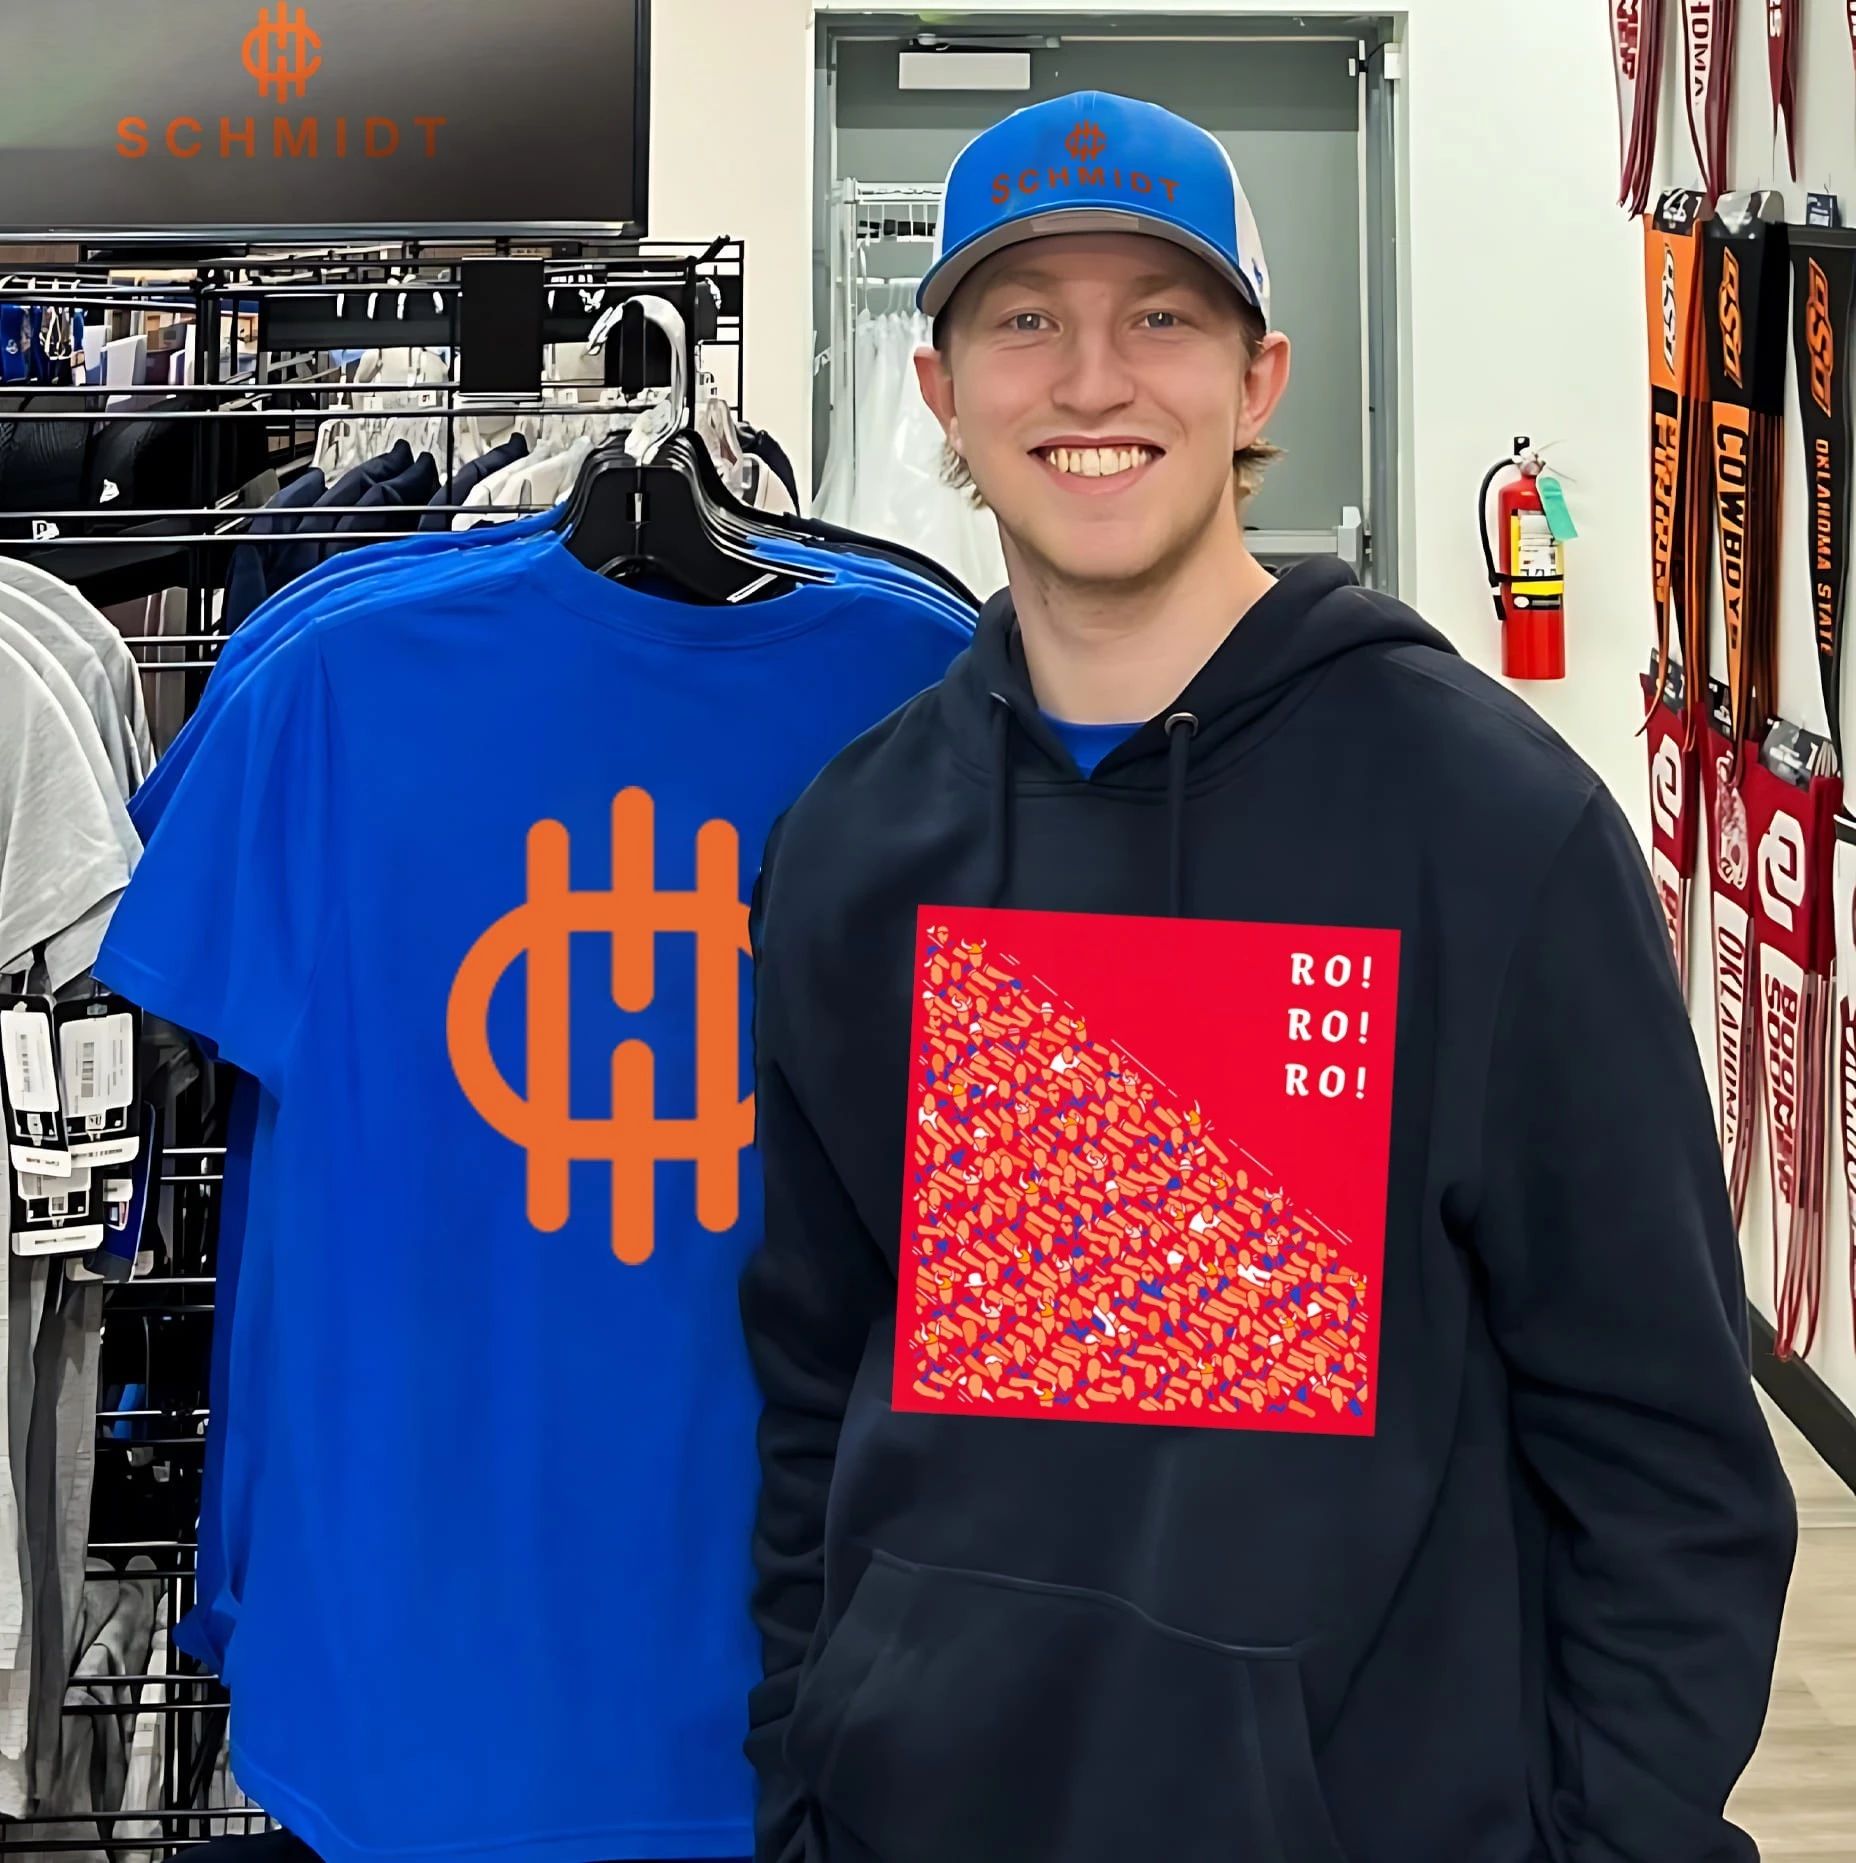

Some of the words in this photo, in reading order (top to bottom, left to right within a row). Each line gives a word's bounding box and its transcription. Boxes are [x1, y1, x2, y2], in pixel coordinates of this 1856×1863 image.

[116, 117, 448, 159] SCHMIDT
[992, 167, 1179, 204] SCHMIDT
[1816, 438, 1831, 569] OKLAHOMA
[1290, 952, 1372, 989] RO!
[1287, 1007, 1369, 1044] RO!
[1284, 1063, 1366, 1100] RO!
